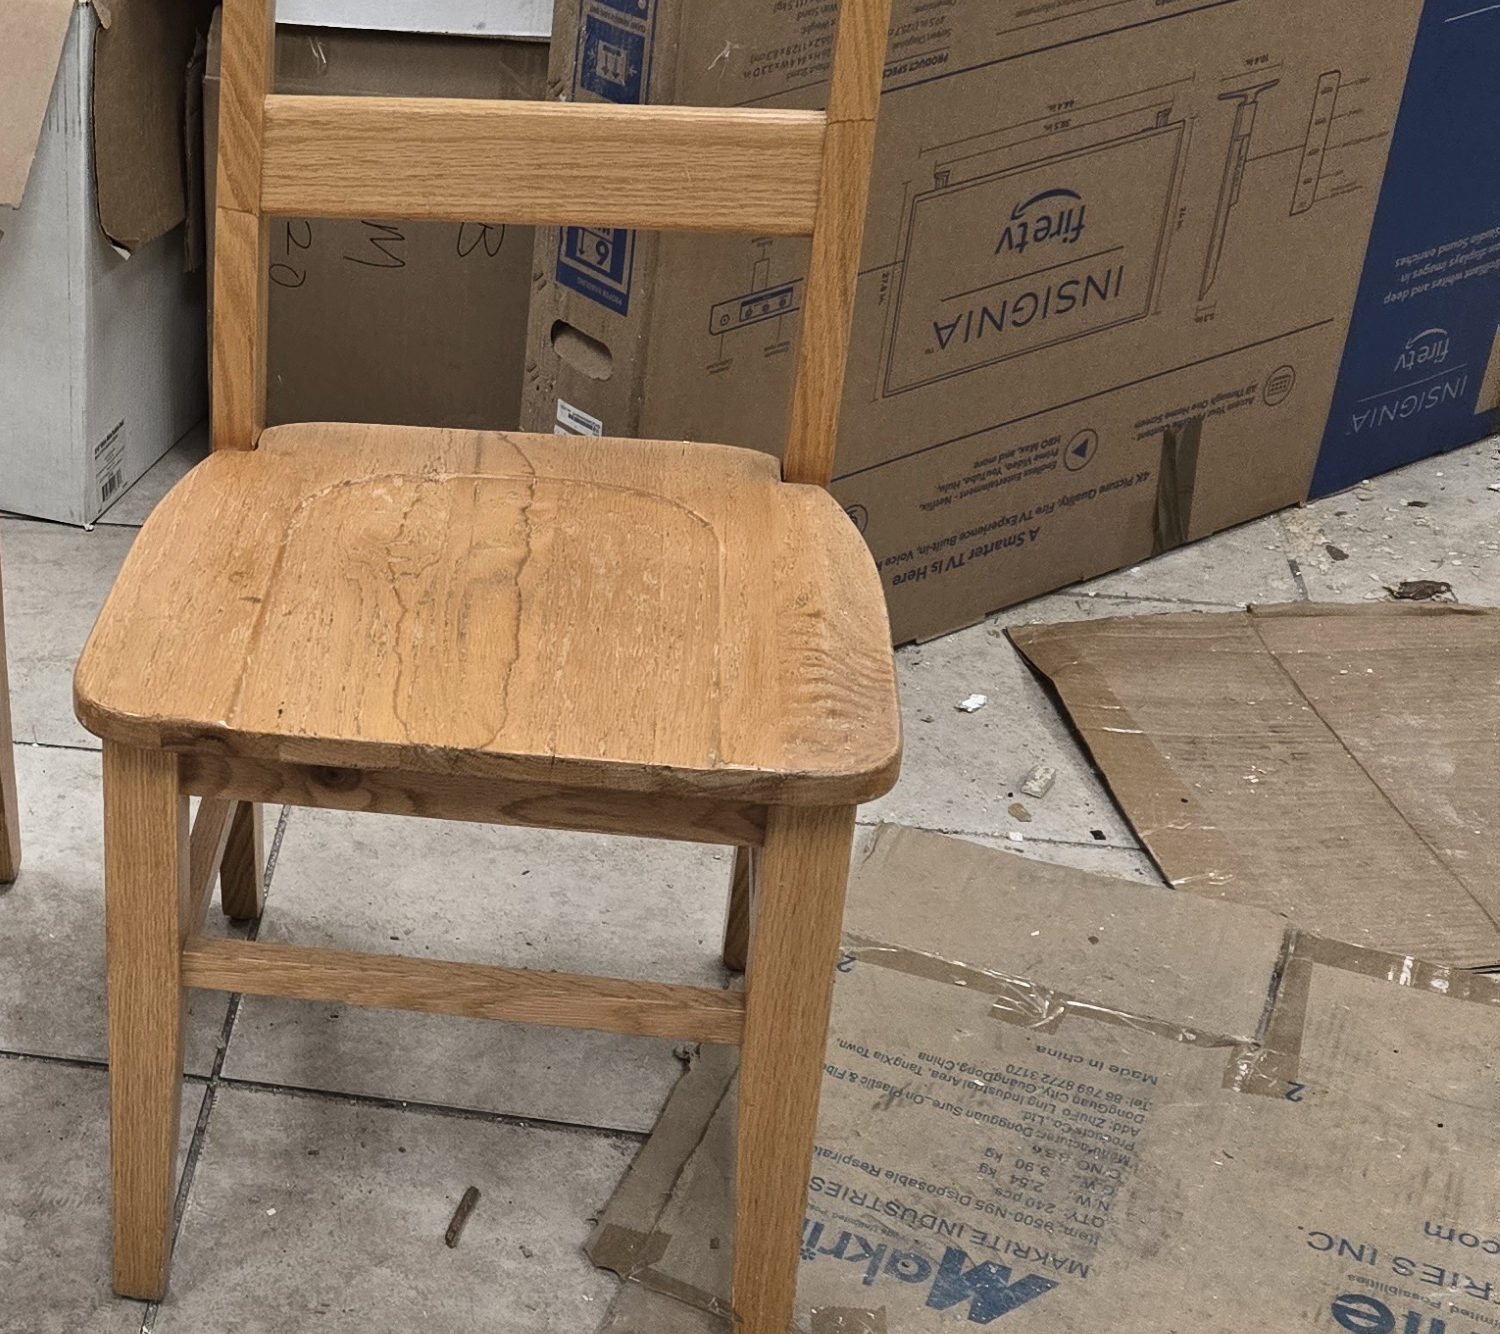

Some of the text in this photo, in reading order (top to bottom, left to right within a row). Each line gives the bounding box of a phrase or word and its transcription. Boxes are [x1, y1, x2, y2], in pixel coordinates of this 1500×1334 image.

[907, 52, 948, 72] PRODUCT
[933, 266, 1124, 348] INSIGNIA
[1353, 376, 1468, 433] INSIGNIA
[1034, 443, 1057, 464] Prime
[963, 462, 1000, 488] YouTube,
[1023, 456, 1056, 480] Endless
[959, 468, 1020, 501] Entertainment
[1099, 473, 1132, 496] Picture
[1036, 500, 1054, 518] Fire
[1058, 484, 1095, 511] Quality,
[959, 511, 1016, 544] Experience
[1018, 507, 1032, 524] TV
[883, 547, 912, 570] Voice
[892, 525, 1039, 589] A Smarter TV Is Here
[834, 951, 857, 975] 2
[832, 1035, 872, 1058] Town,
[870, 1046, 926, 1076] TangXia
[1004, 1060, 1040, 1082] 3170
[1032, 1040, 1159, 1088] Made in china
[846, 1070, 859, 1084] &
[856, 1073, 905, 1098] Plastic
[1036, 1069, 1076, 1093] 8772
[960, 1075, 1026, 1107] Industrial
[1074, 1080, 1106, 1101] 769
[1103, 1089, 1124, 1106] 86
[1285, 1080, 1307, 1104] 2
[1024, 1093, 1058, 1116] Ling
[962, 1103, 1035, 1138] Dongguan
[1105, 1118, 1141, 1141] Add:
[981, 1143, 1005, 1163] kg
[881, 1165, 974, 1208] Disposable
[974, 1159, 1046, 1194] 2.54 kg
[991, 1181, 1024, 1204] pcs
[1023, 1194, 1057, 1215] 240
[808, 1177, 967, 1240] INDUSTRIES
[972, 1196, 1057, 1233] 9500-N95
[968, 1229, 1093, 1279] MAKRITE
[800, 1218, 1060, 1324] Makri
[1391, 1255, 1500, 1306] RIES
[1346, 1273, 1442, 1310] Possibilities
